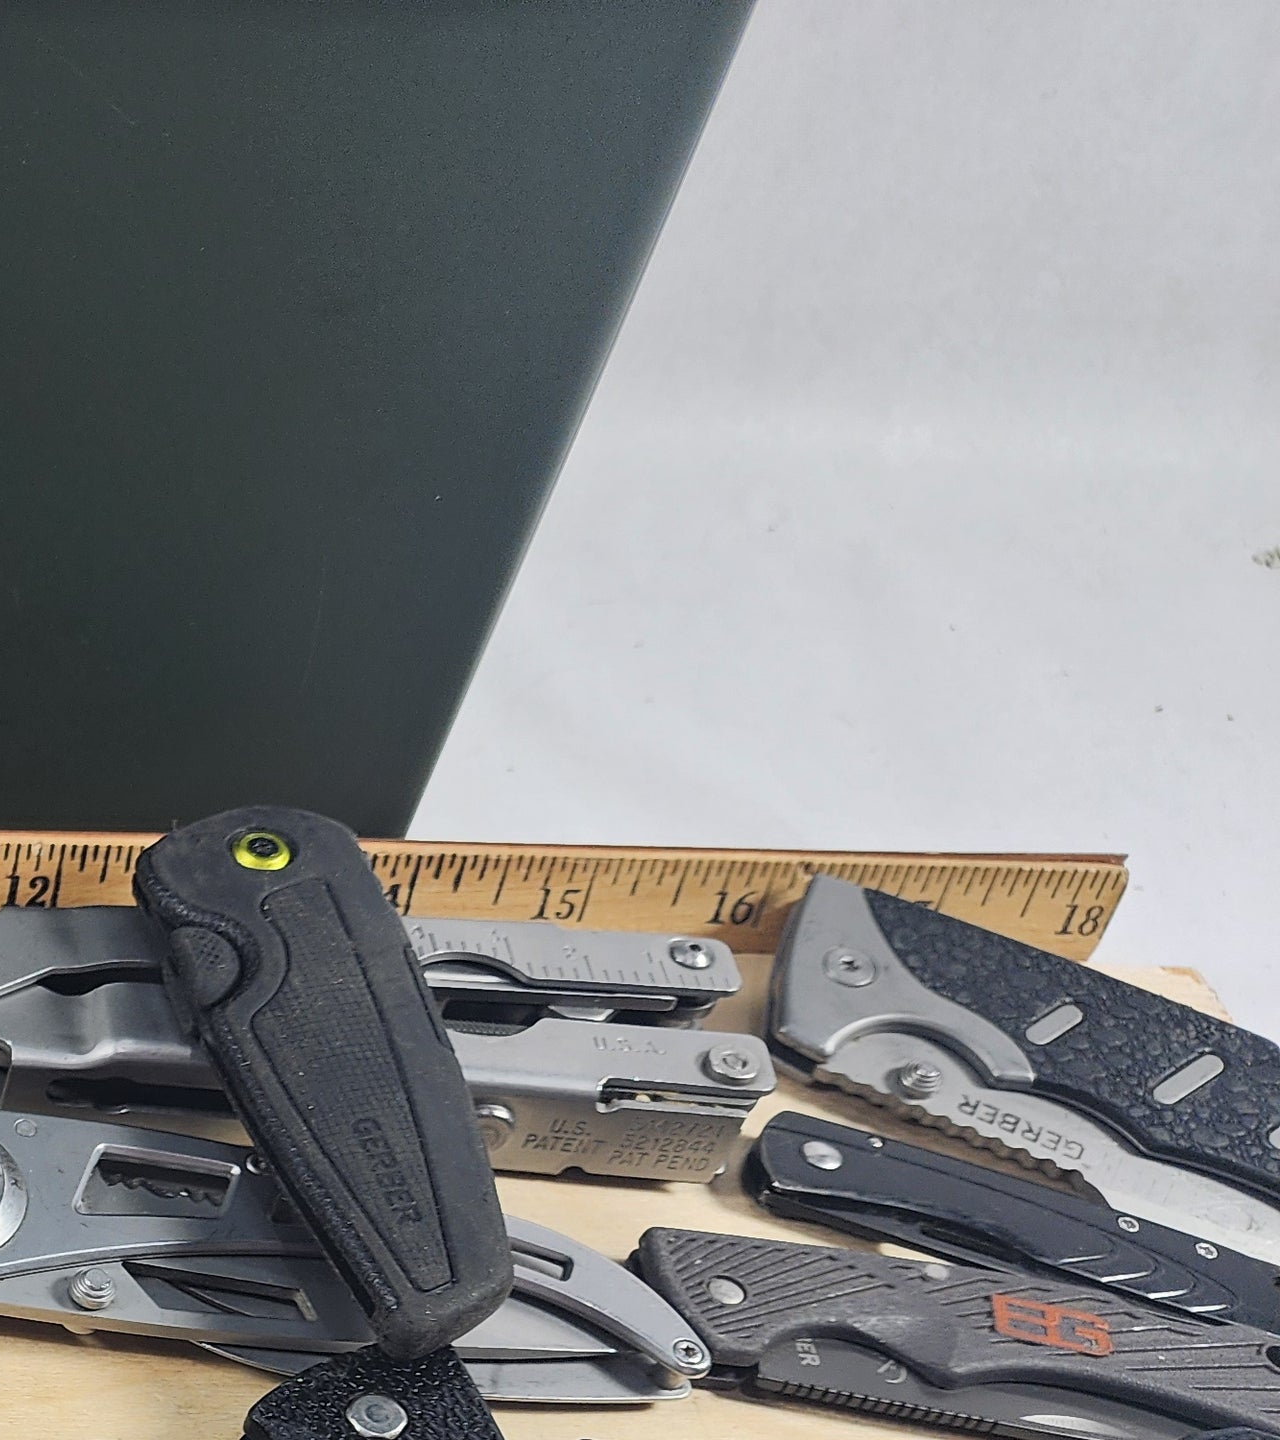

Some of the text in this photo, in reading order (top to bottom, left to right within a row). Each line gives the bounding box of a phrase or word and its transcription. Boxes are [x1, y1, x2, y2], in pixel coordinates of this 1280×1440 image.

[0, 875, 51, 907] 12
[530, 888, 581, 920] 15
[705, 890, 756, 926] 16
[1055, 904, 1105, 937] 18
[521, 1132, 607, 1154] PATENT
[956, 1093, 1086, 1161] GERBER
[350, 1117, 423, 1223] GERBER
